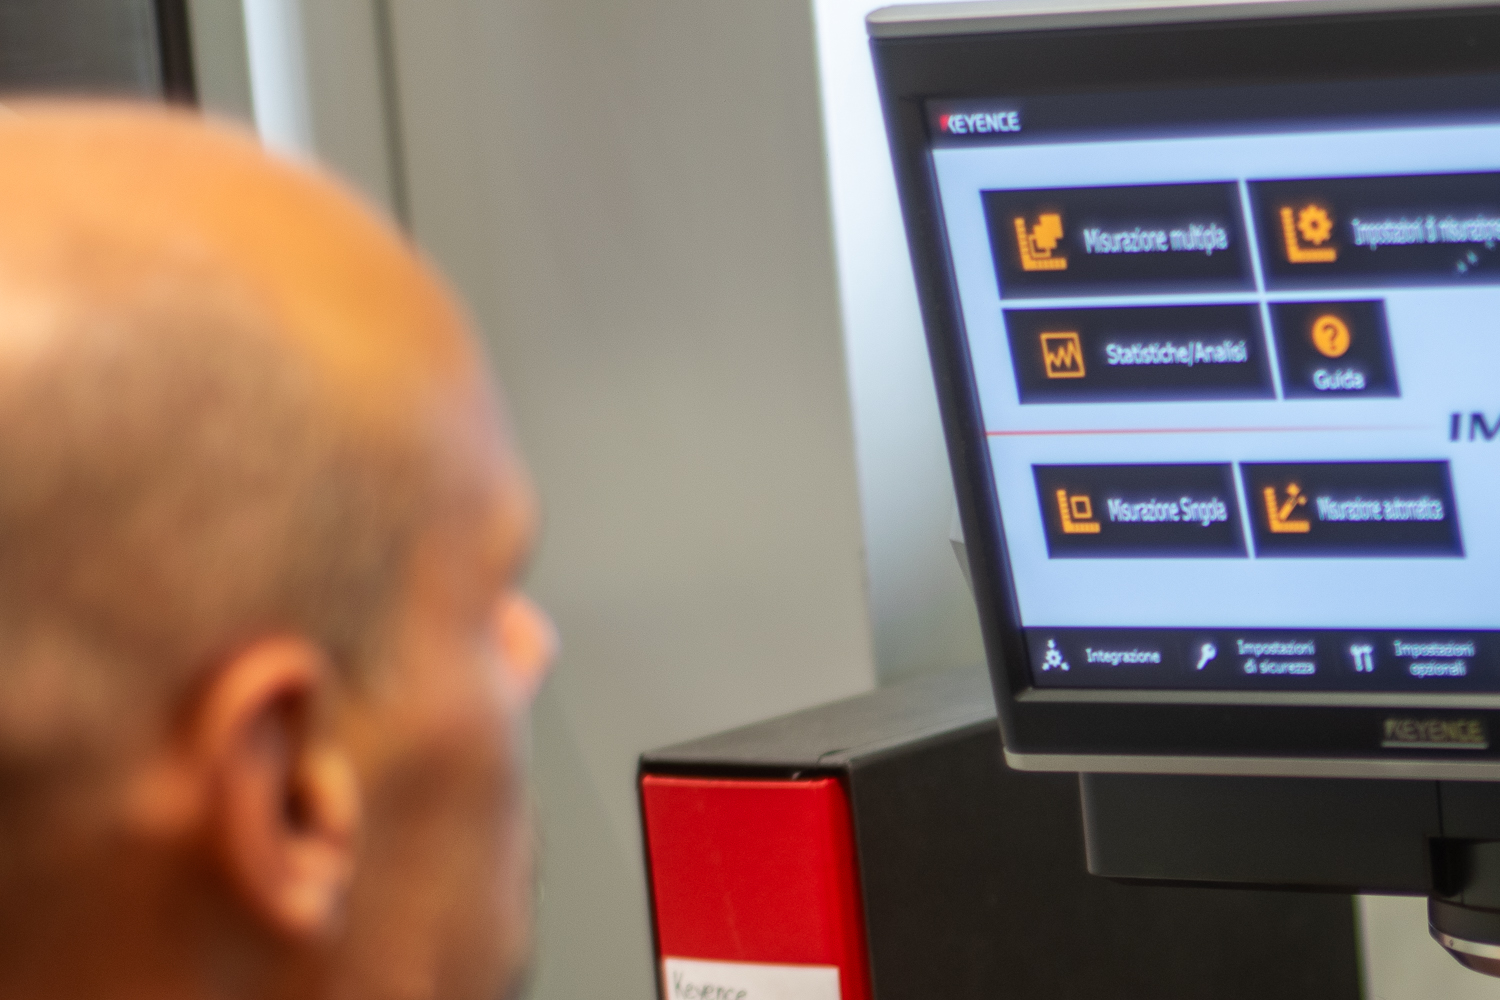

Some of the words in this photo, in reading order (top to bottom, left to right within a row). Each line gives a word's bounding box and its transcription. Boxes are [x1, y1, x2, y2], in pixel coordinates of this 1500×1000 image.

[940, 112, 1021, 134] KEYENCE
[1083, 227, 1168, 254] Misurazione
[1169, 223, 1228, 256] multipla
[1106, 340, 1248, 367] Statistiche/Analisi
[1313, 369, 1365, 391] Guida
[1107, 498, 1180, 522] Misurazione
[1180, 497, 1228, 527] Singola
[1086, 648, 1161, 666] Integrazione
[1237, 640, 1316, 657] Impostazioni
[1394, 640, 1475, 659] Impostazioni
[1244, 658, 1257, 674] di
[1259, 659, 1316, 675] sicurezza
[1409, 660, 1467, 678] opzionali
[1384, 719, 1486, 742] KEYENCE
